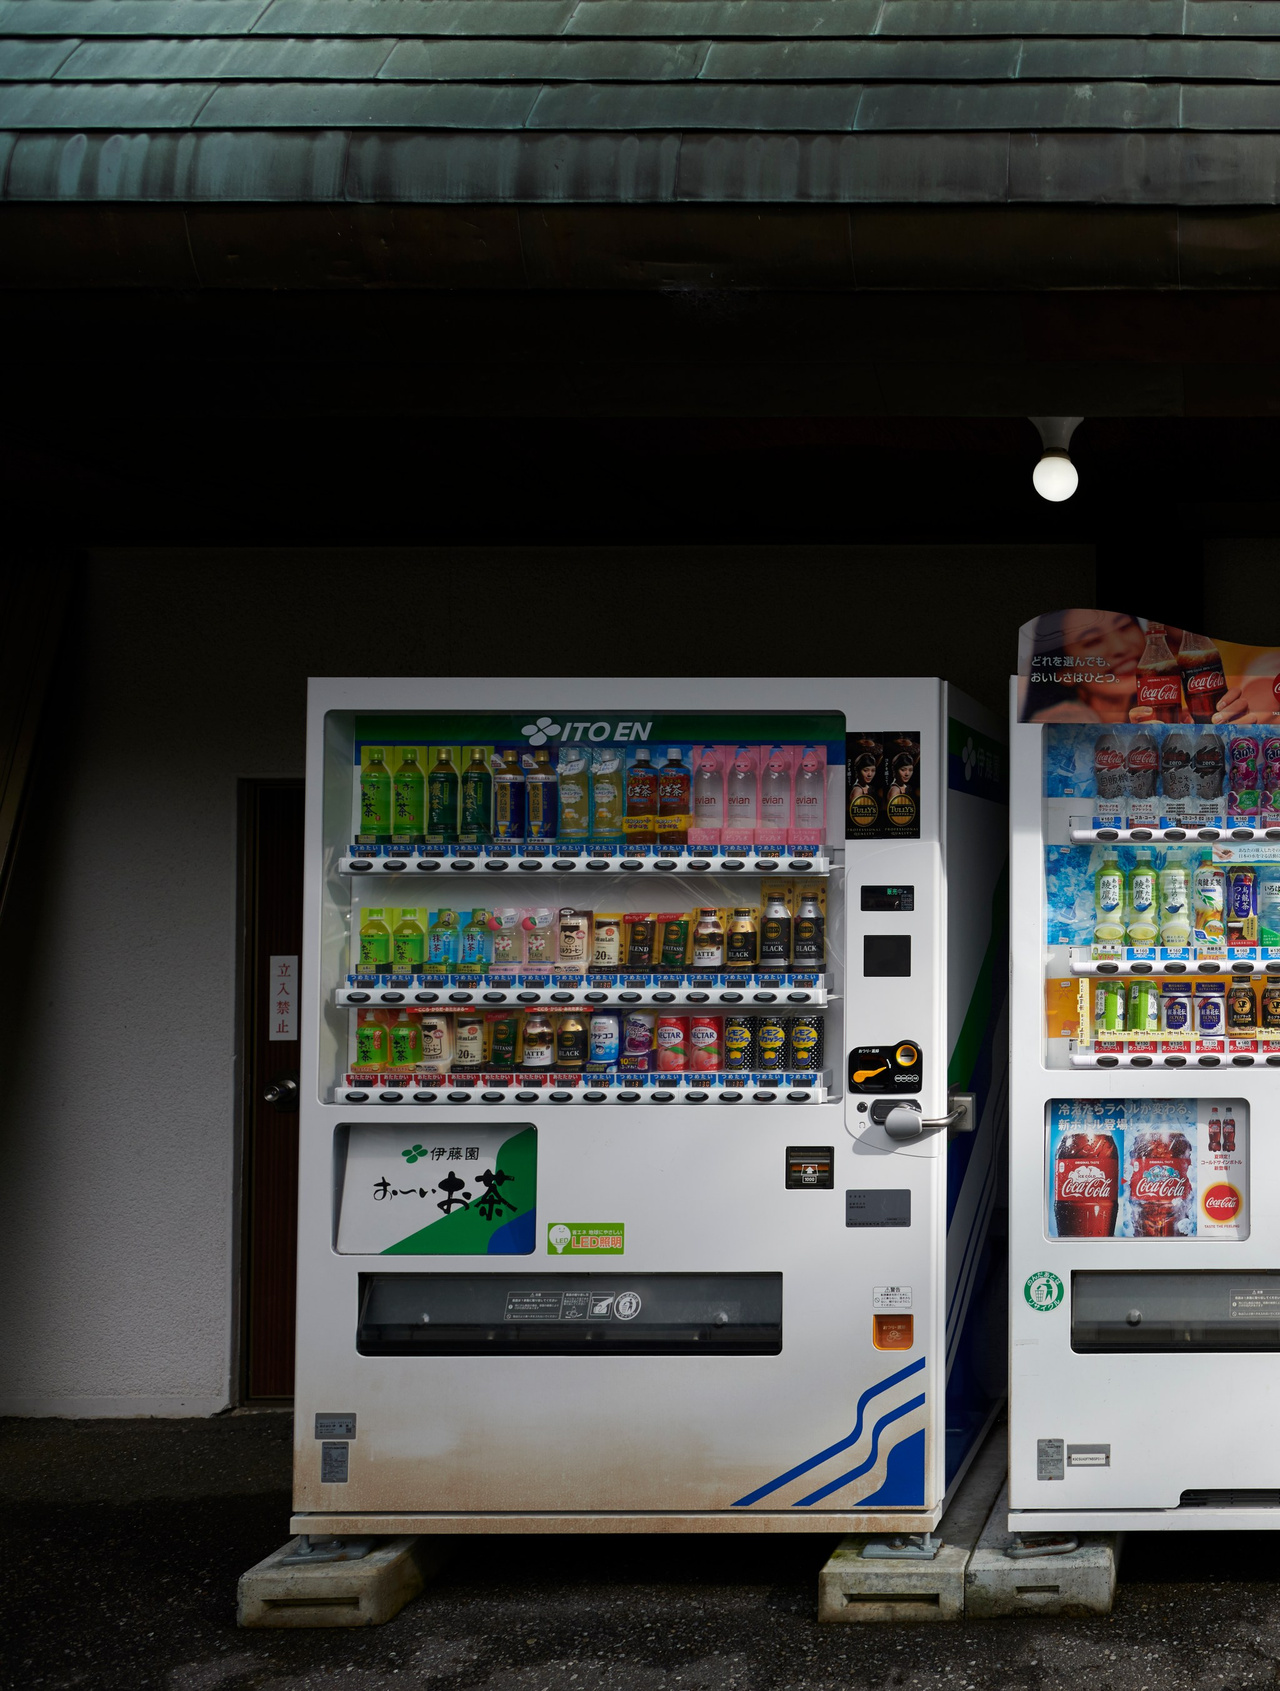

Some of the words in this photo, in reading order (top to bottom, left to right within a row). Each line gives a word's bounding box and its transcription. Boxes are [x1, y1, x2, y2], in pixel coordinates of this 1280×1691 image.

[1031, 656, 1111, 667] どれを選んでも、
[1030, 672, 1121, 684] おいしさはひとつ。
[1187, 671, 1225, 692] Coca-Cola
[1140, 685, 1178, 701] Coca-Cola
[560, 721, 610, 743] ITO
[614, 721, 653, 743] EN
[1231, 746, 1255, 762] Fanta
[695, 796, 716, 804] evian
[728, 796, 750, 804] evian
[762, 796, 783, 804] evian
[796, 796, 818, 804] evian
[852, 805, 876, 814] TULLY'S
[889, 805, 914, 814] TULLY'S
[1101, 880, 1111, 900] 綾鷹
[1241, 886, 1250, 911] 烏龍茶
[276, 963, 291, 1033] 立入禁止
[1058, 1103, 1192, 1116] 冷えたらラベルが変わる、
[1058, 1119, 1133, 1131] 新ボトル登場!
[430, 1147, 479, 1161] 伊藤園
[1061, 1177, 1112, 1198] Coca-Cola
[1136, 1177, 1186, 1197] Coca-Cola
[1206, 1196, 1237, 1208] Coca-Cola
[571, 1236, 622, 1249] LED照明
[1026, 1271, 1062, 1287] のんだあとは
[1027, 1298, 1062, 1312] リサイクル
